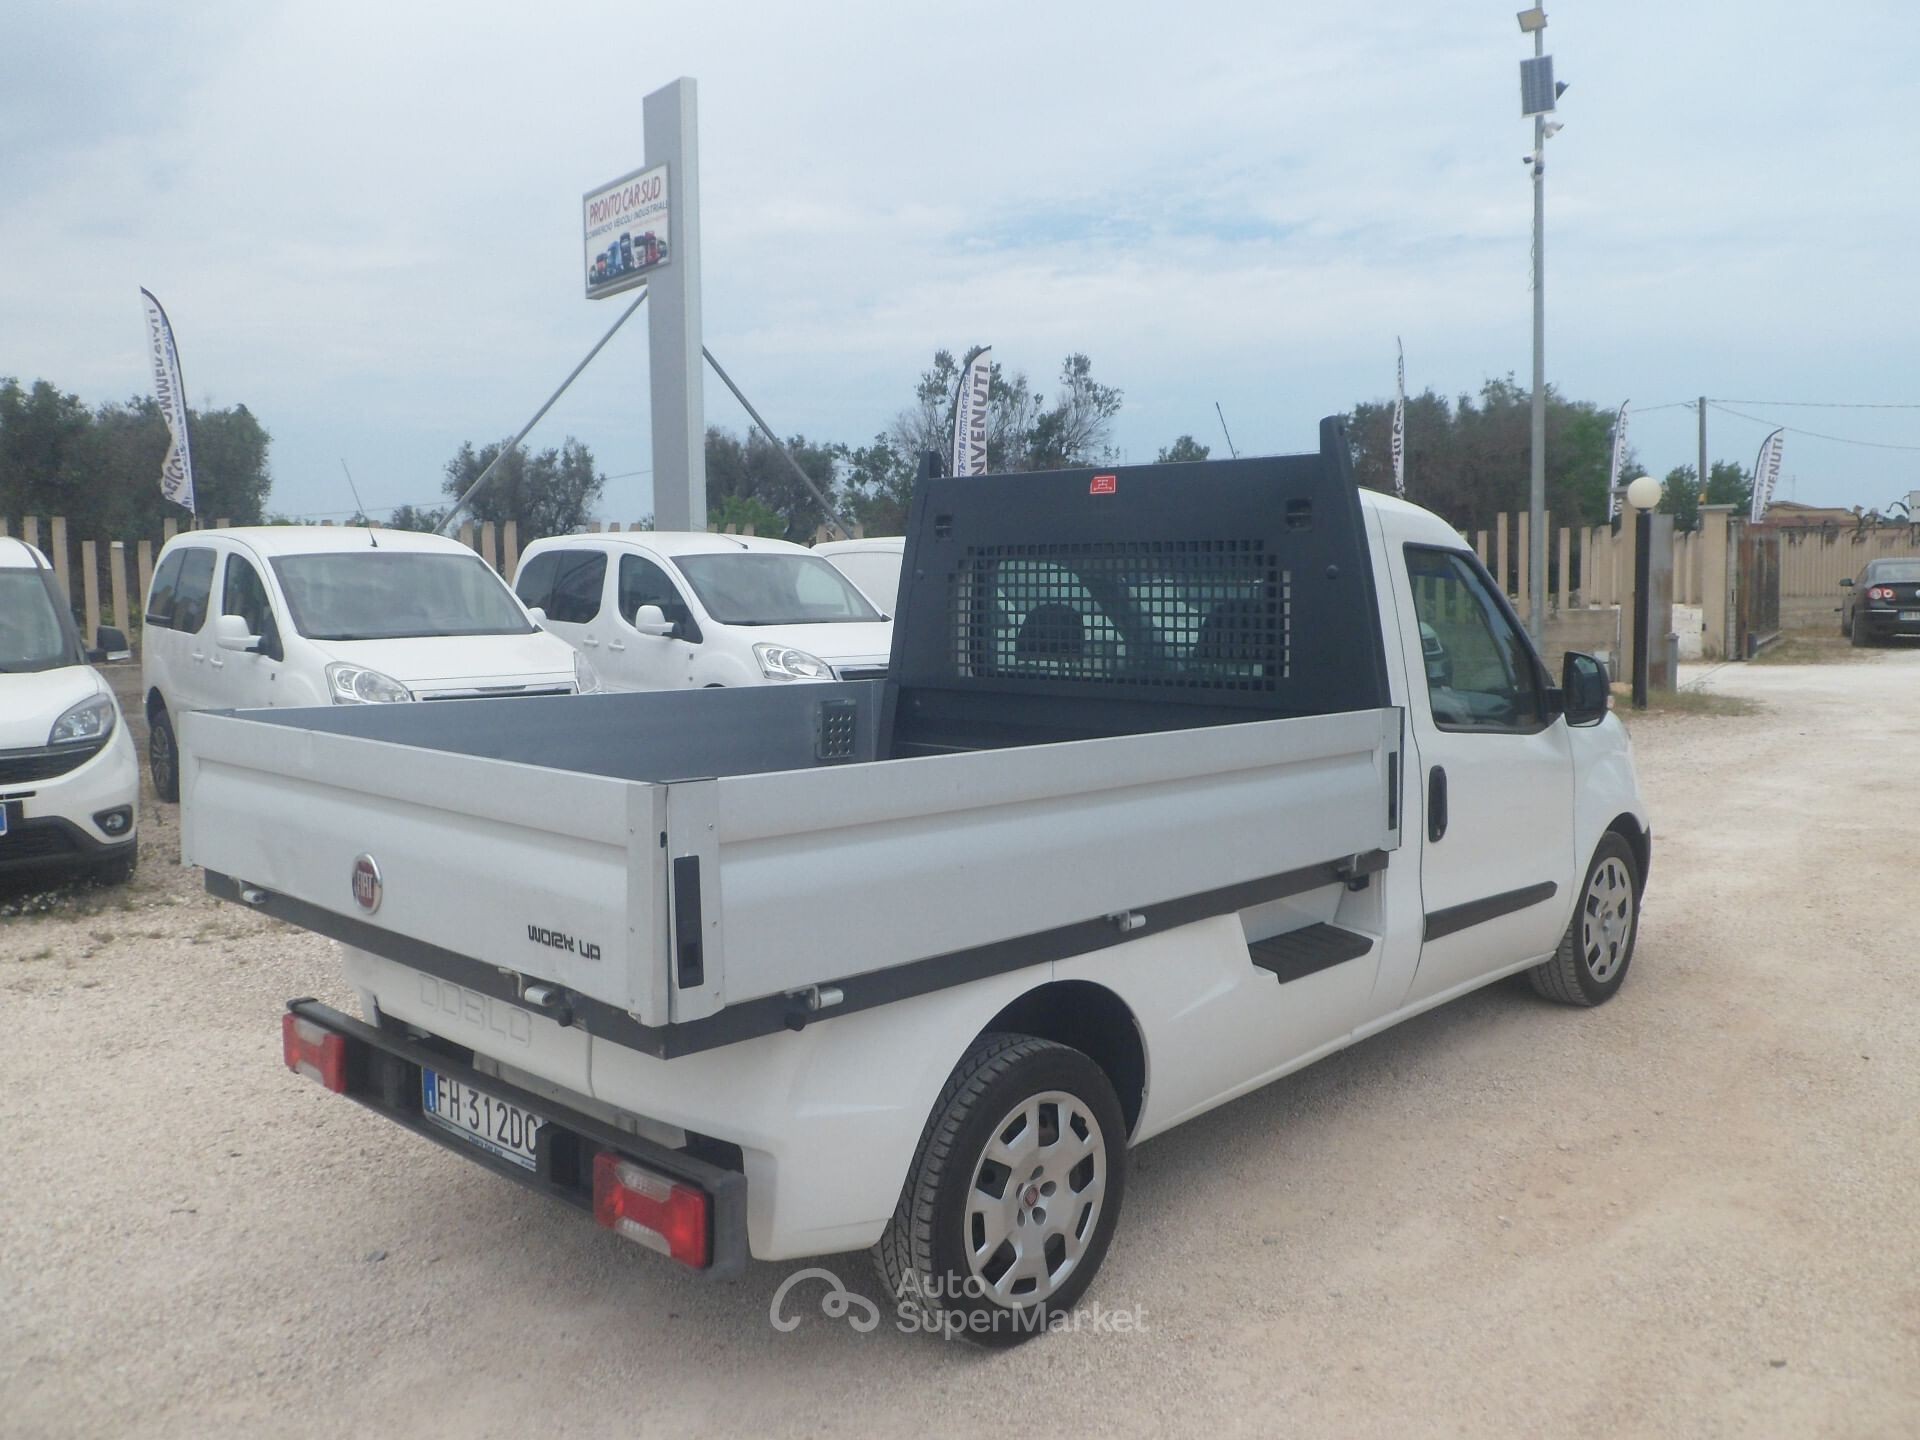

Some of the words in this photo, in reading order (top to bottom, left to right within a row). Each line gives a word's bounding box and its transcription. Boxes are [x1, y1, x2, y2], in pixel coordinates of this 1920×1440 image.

[589, 191, 622, 226] PRONTO
[622, 183, 641, 212] CAR
[641, 176, 661, 204] SUD
[970, 365, 989, 476] NVENUTI
[357, 871, 375, 900] FIAT
